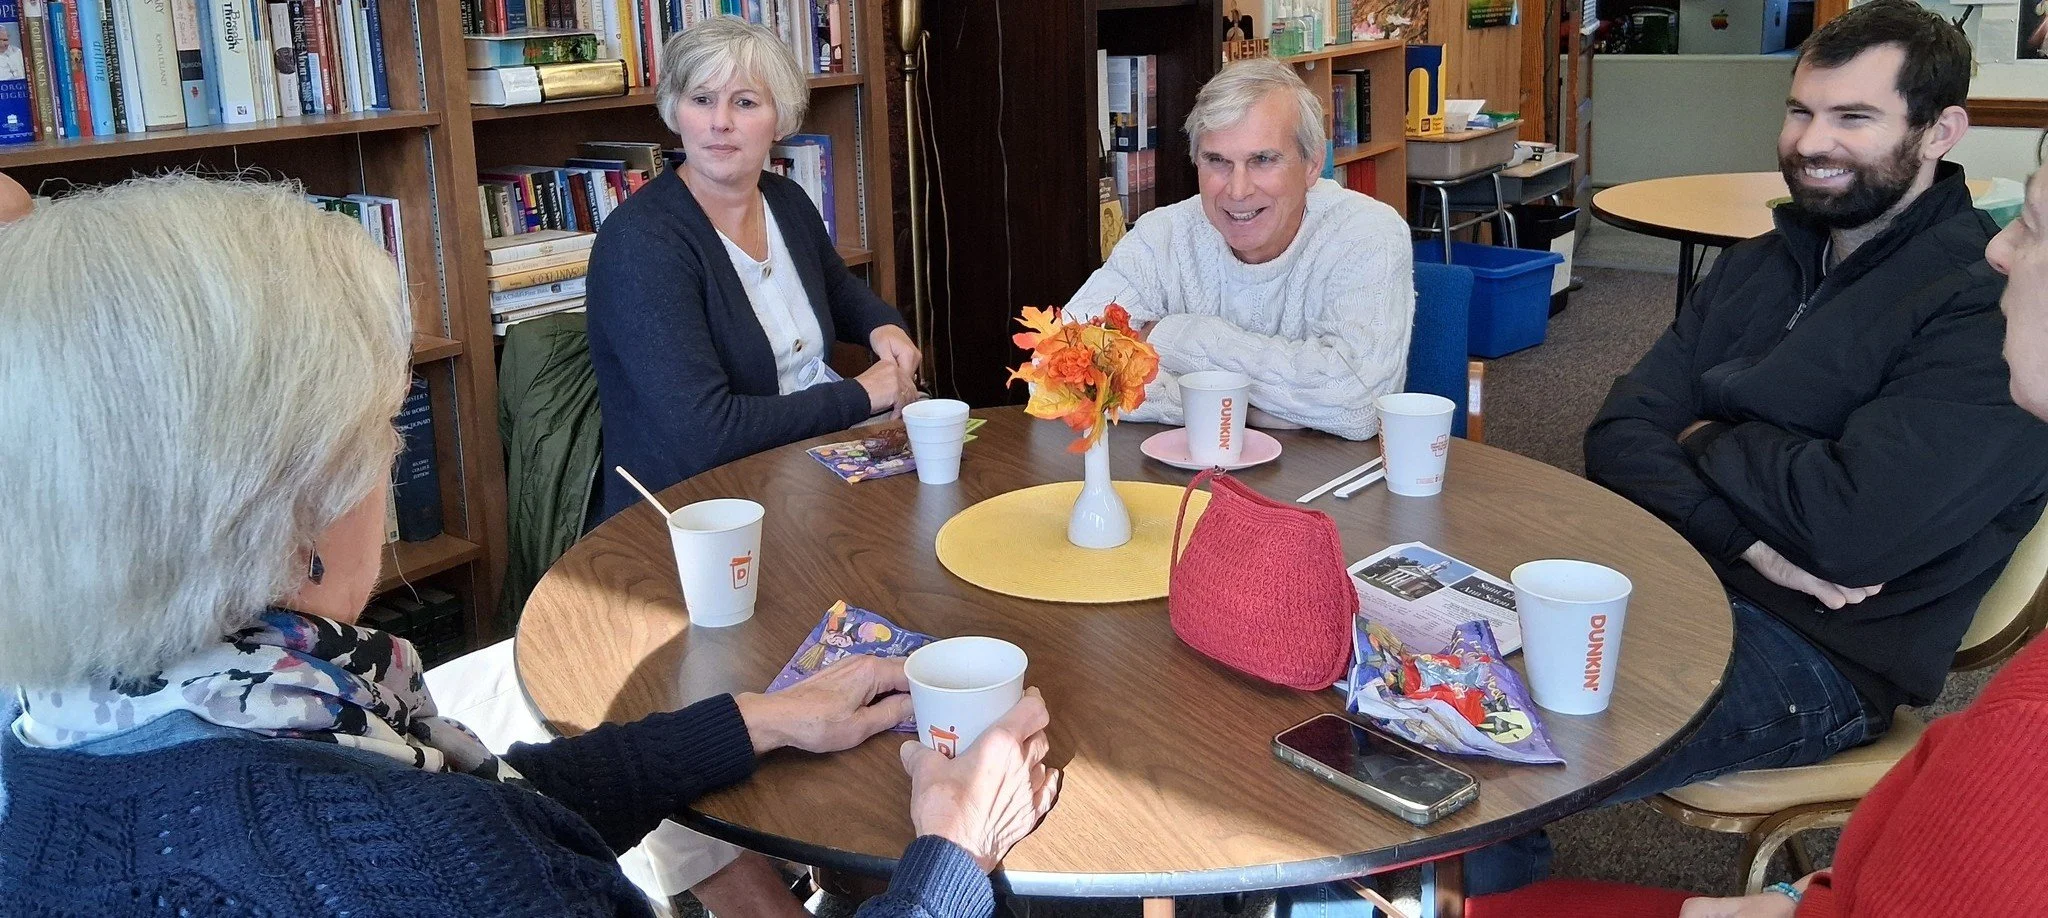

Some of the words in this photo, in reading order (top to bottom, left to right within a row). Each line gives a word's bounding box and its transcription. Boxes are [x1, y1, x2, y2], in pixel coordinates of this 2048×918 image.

[31, 21, 42, 43] POPE
[224, 2, 236, 50] Through
[33, 47, 48, 87] FRANCIS
[92, 41, 105, 82] drifting
[587, 181, 595, 206] PATRICK
[1219, 397, 1233, 450] DUNKIN'
[737, 568, 747, 580] D
[1477, 582, 1502, 596] Saint
[1460, 586, 1482, 597] Ann
[1483, 593, 1511, 607] Seton
[1583, 614, 1607, 692] DUNKIN'
